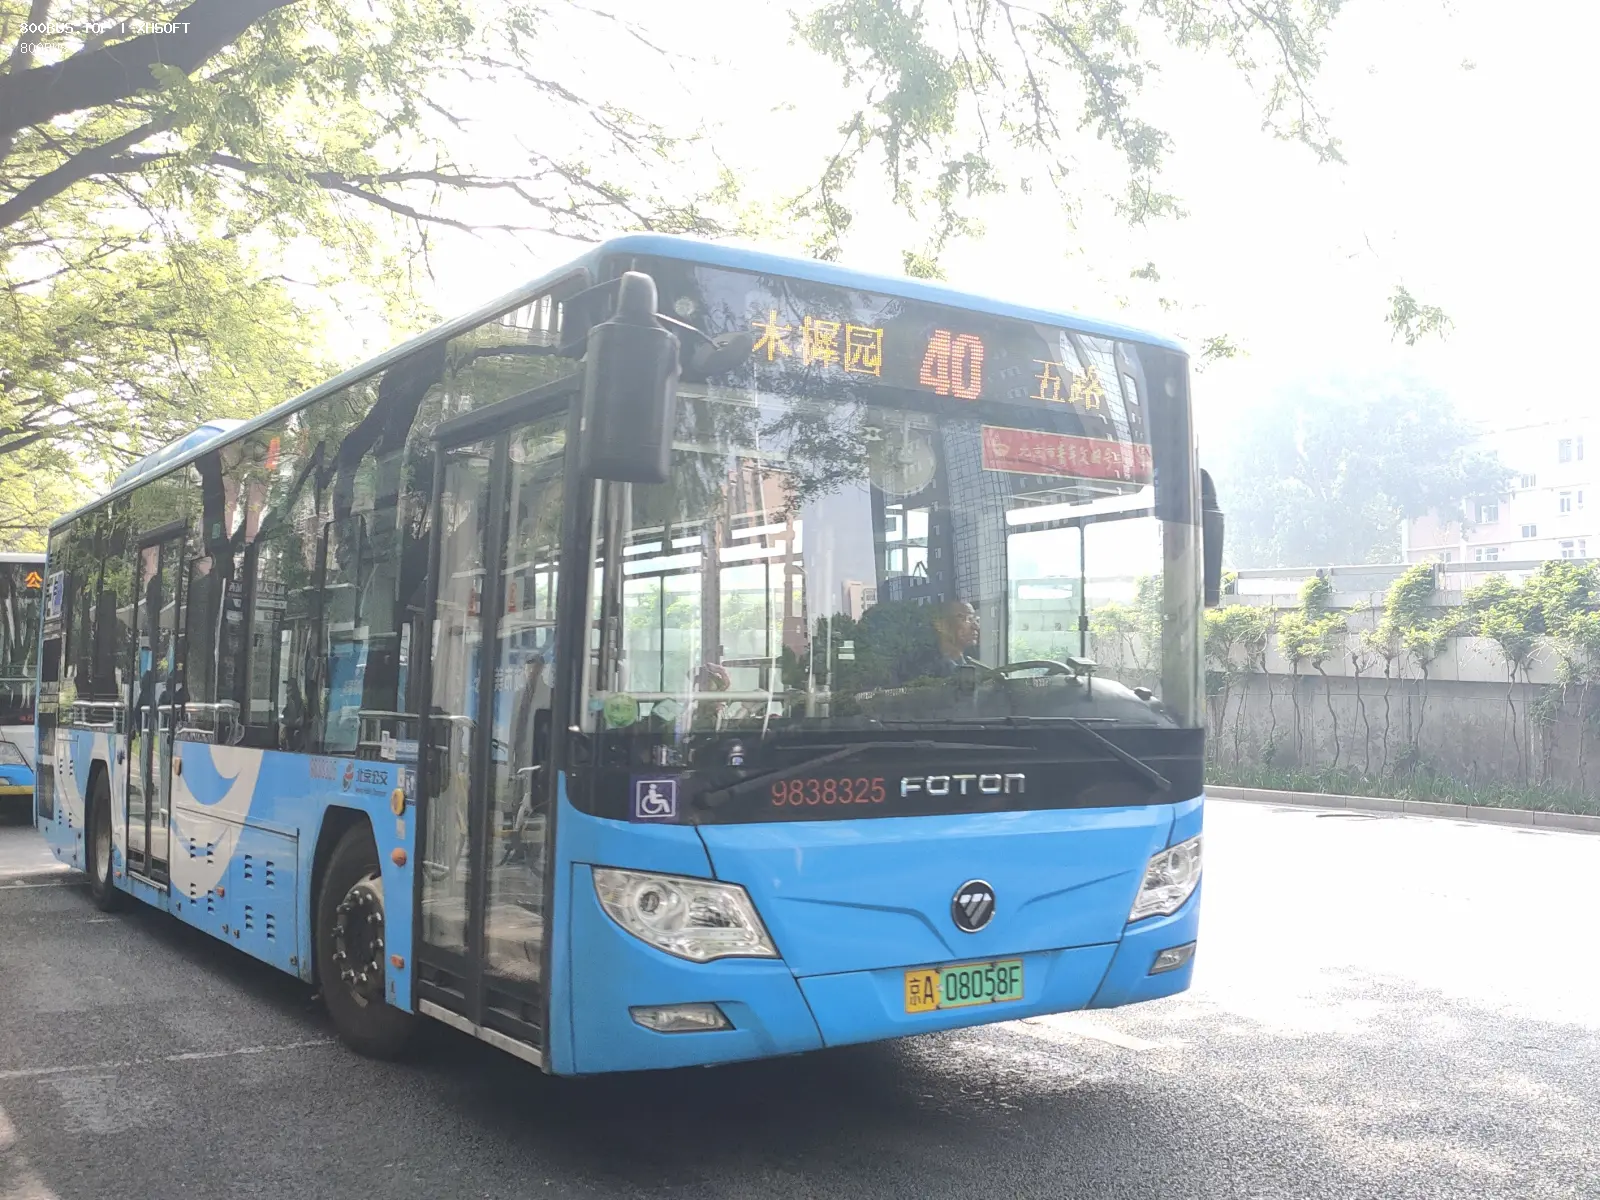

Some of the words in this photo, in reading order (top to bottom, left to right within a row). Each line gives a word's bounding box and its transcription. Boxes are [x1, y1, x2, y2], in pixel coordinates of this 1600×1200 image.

[919, 328, 985, 400] 40
[771, 777, 886, 807] 9838325
[900, 772, 1026, 797] FOTON
